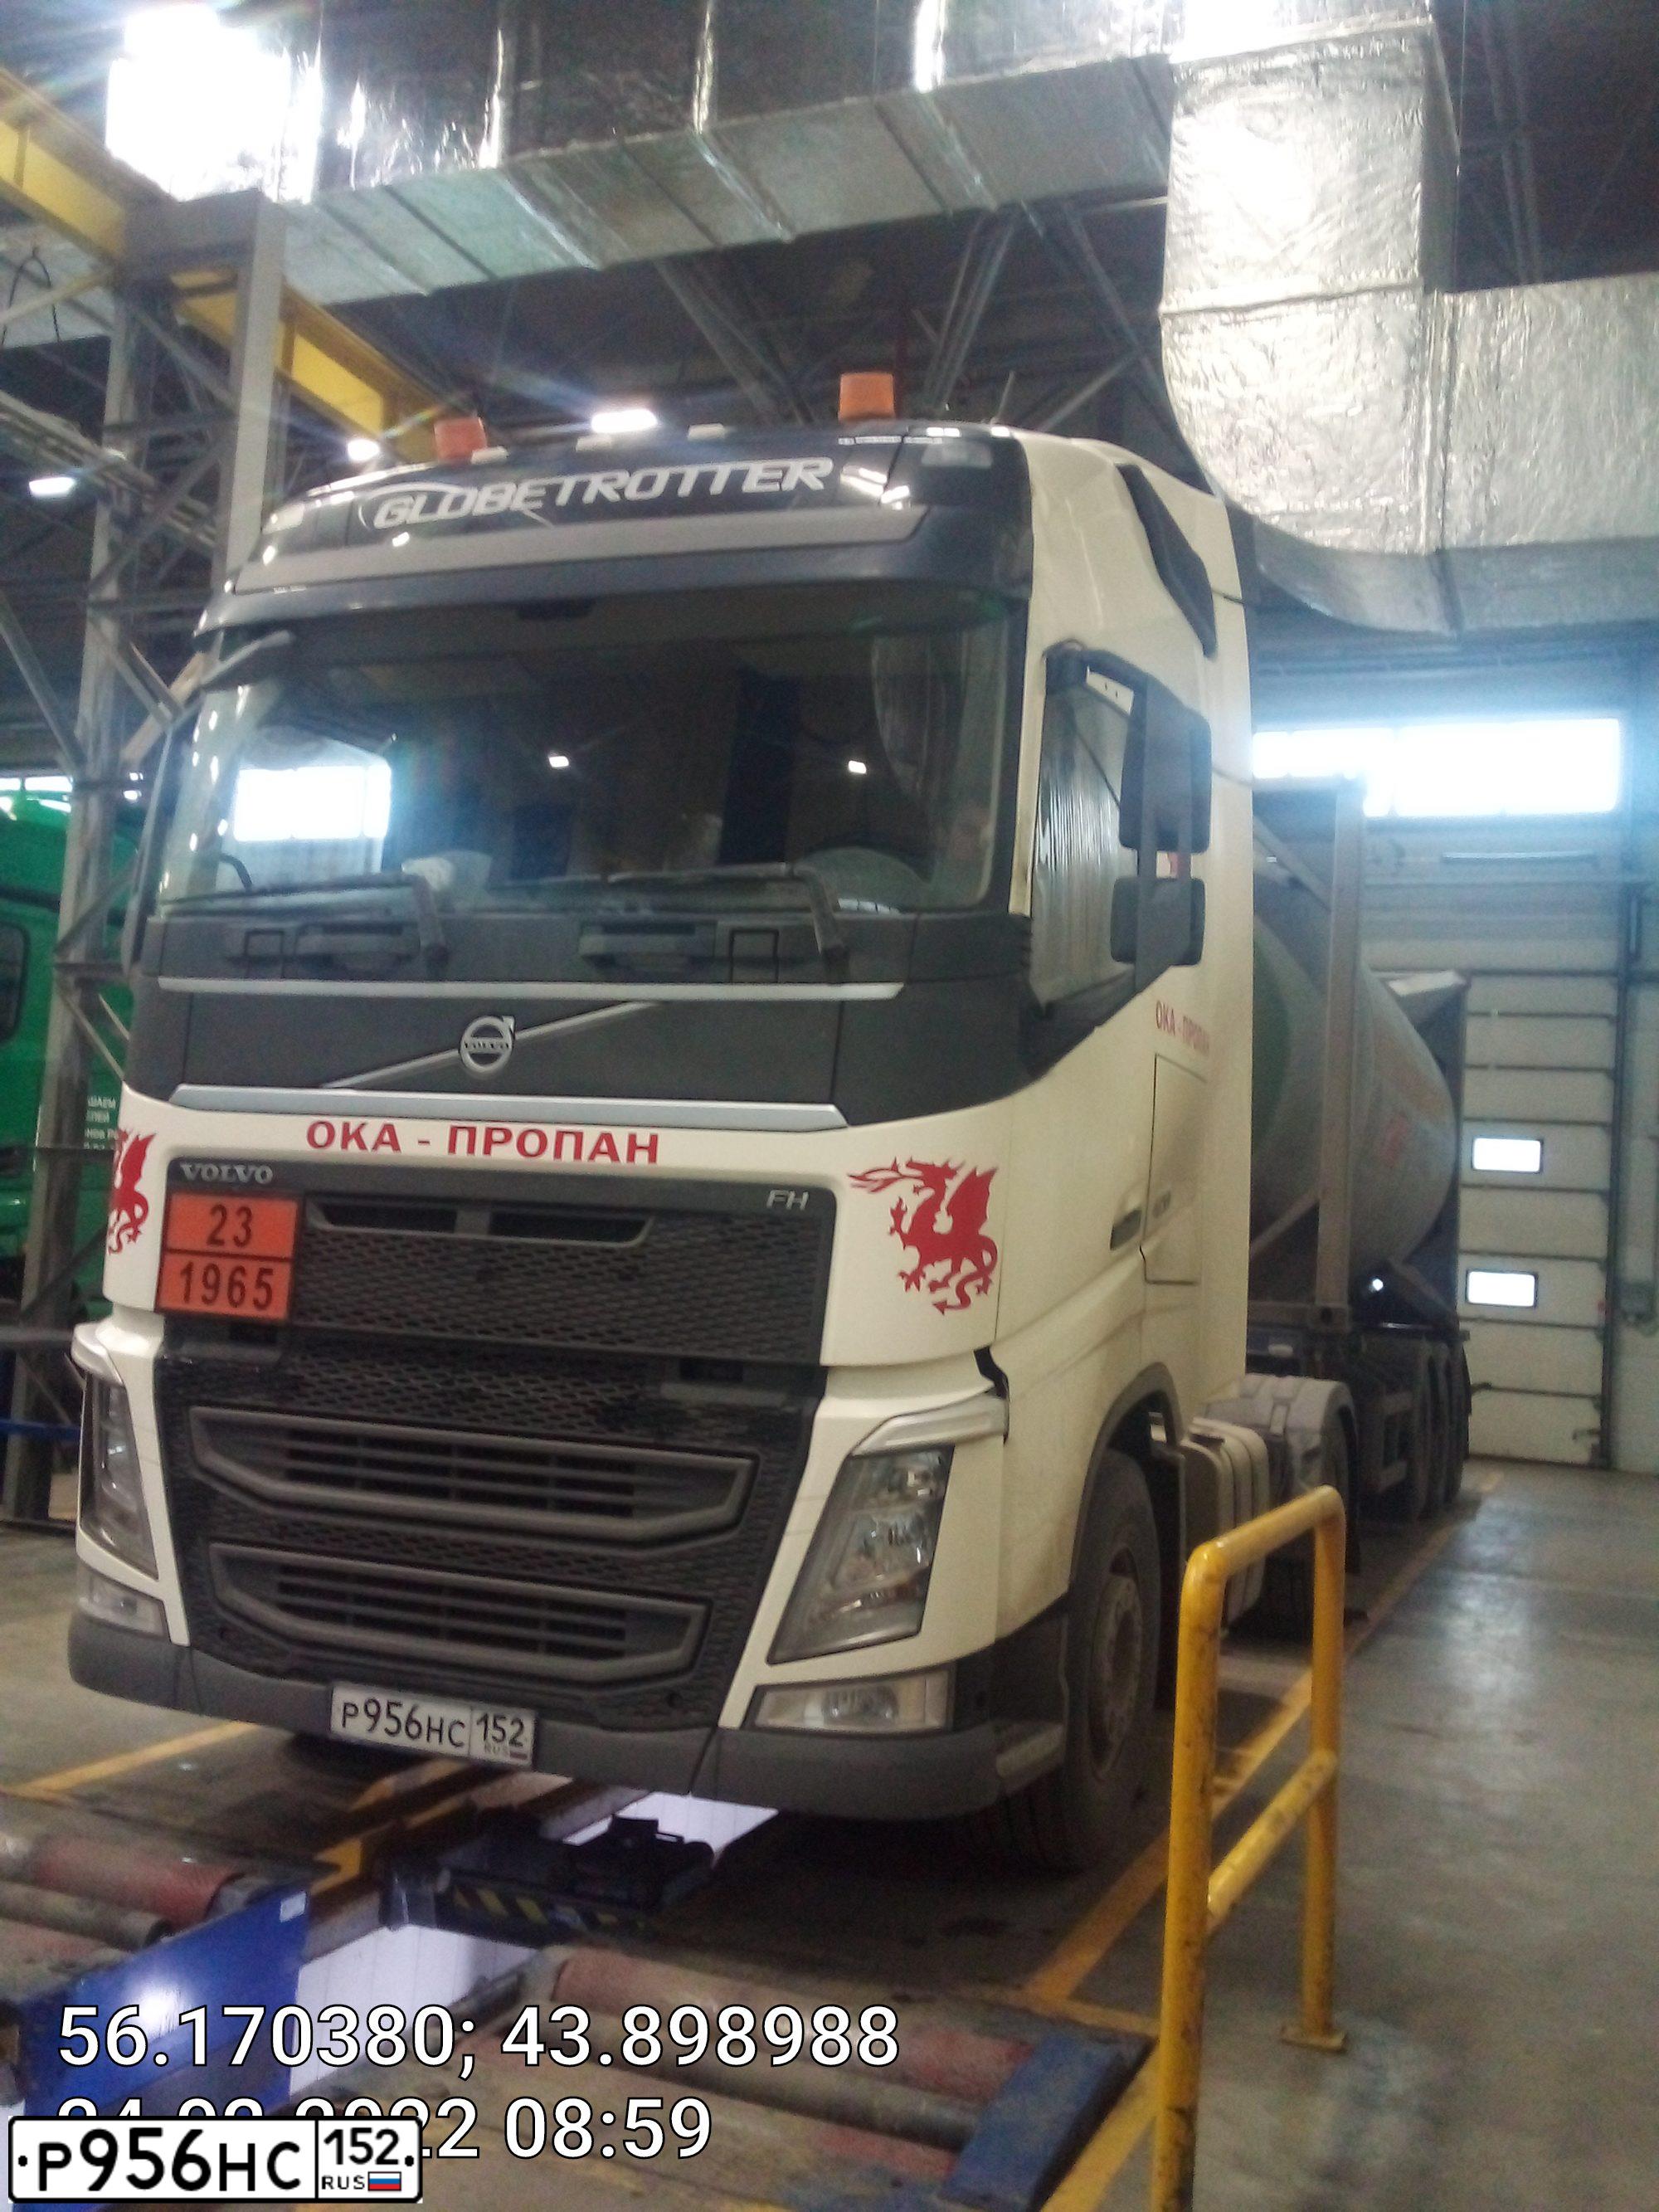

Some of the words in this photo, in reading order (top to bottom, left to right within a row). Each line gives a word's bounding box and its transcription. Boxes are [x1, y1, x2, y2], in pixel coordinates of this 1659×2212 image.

[372, 456, 834, 529] GLOBETROTTER
[1155, 1000, 1175, 1036] ОКА
[306, 1121, 401, 1153] ОКА
[447, 1125, 659, 1164] ПРОПАН
[179, 1162, 274, 1184] VOLVO
[766, 1189, 810, 1211] FH
[207, 1204, 253, 1248] 23
[180, 1261, 275, 1311] 1965
[476, 1713, 525, 1747] 152
